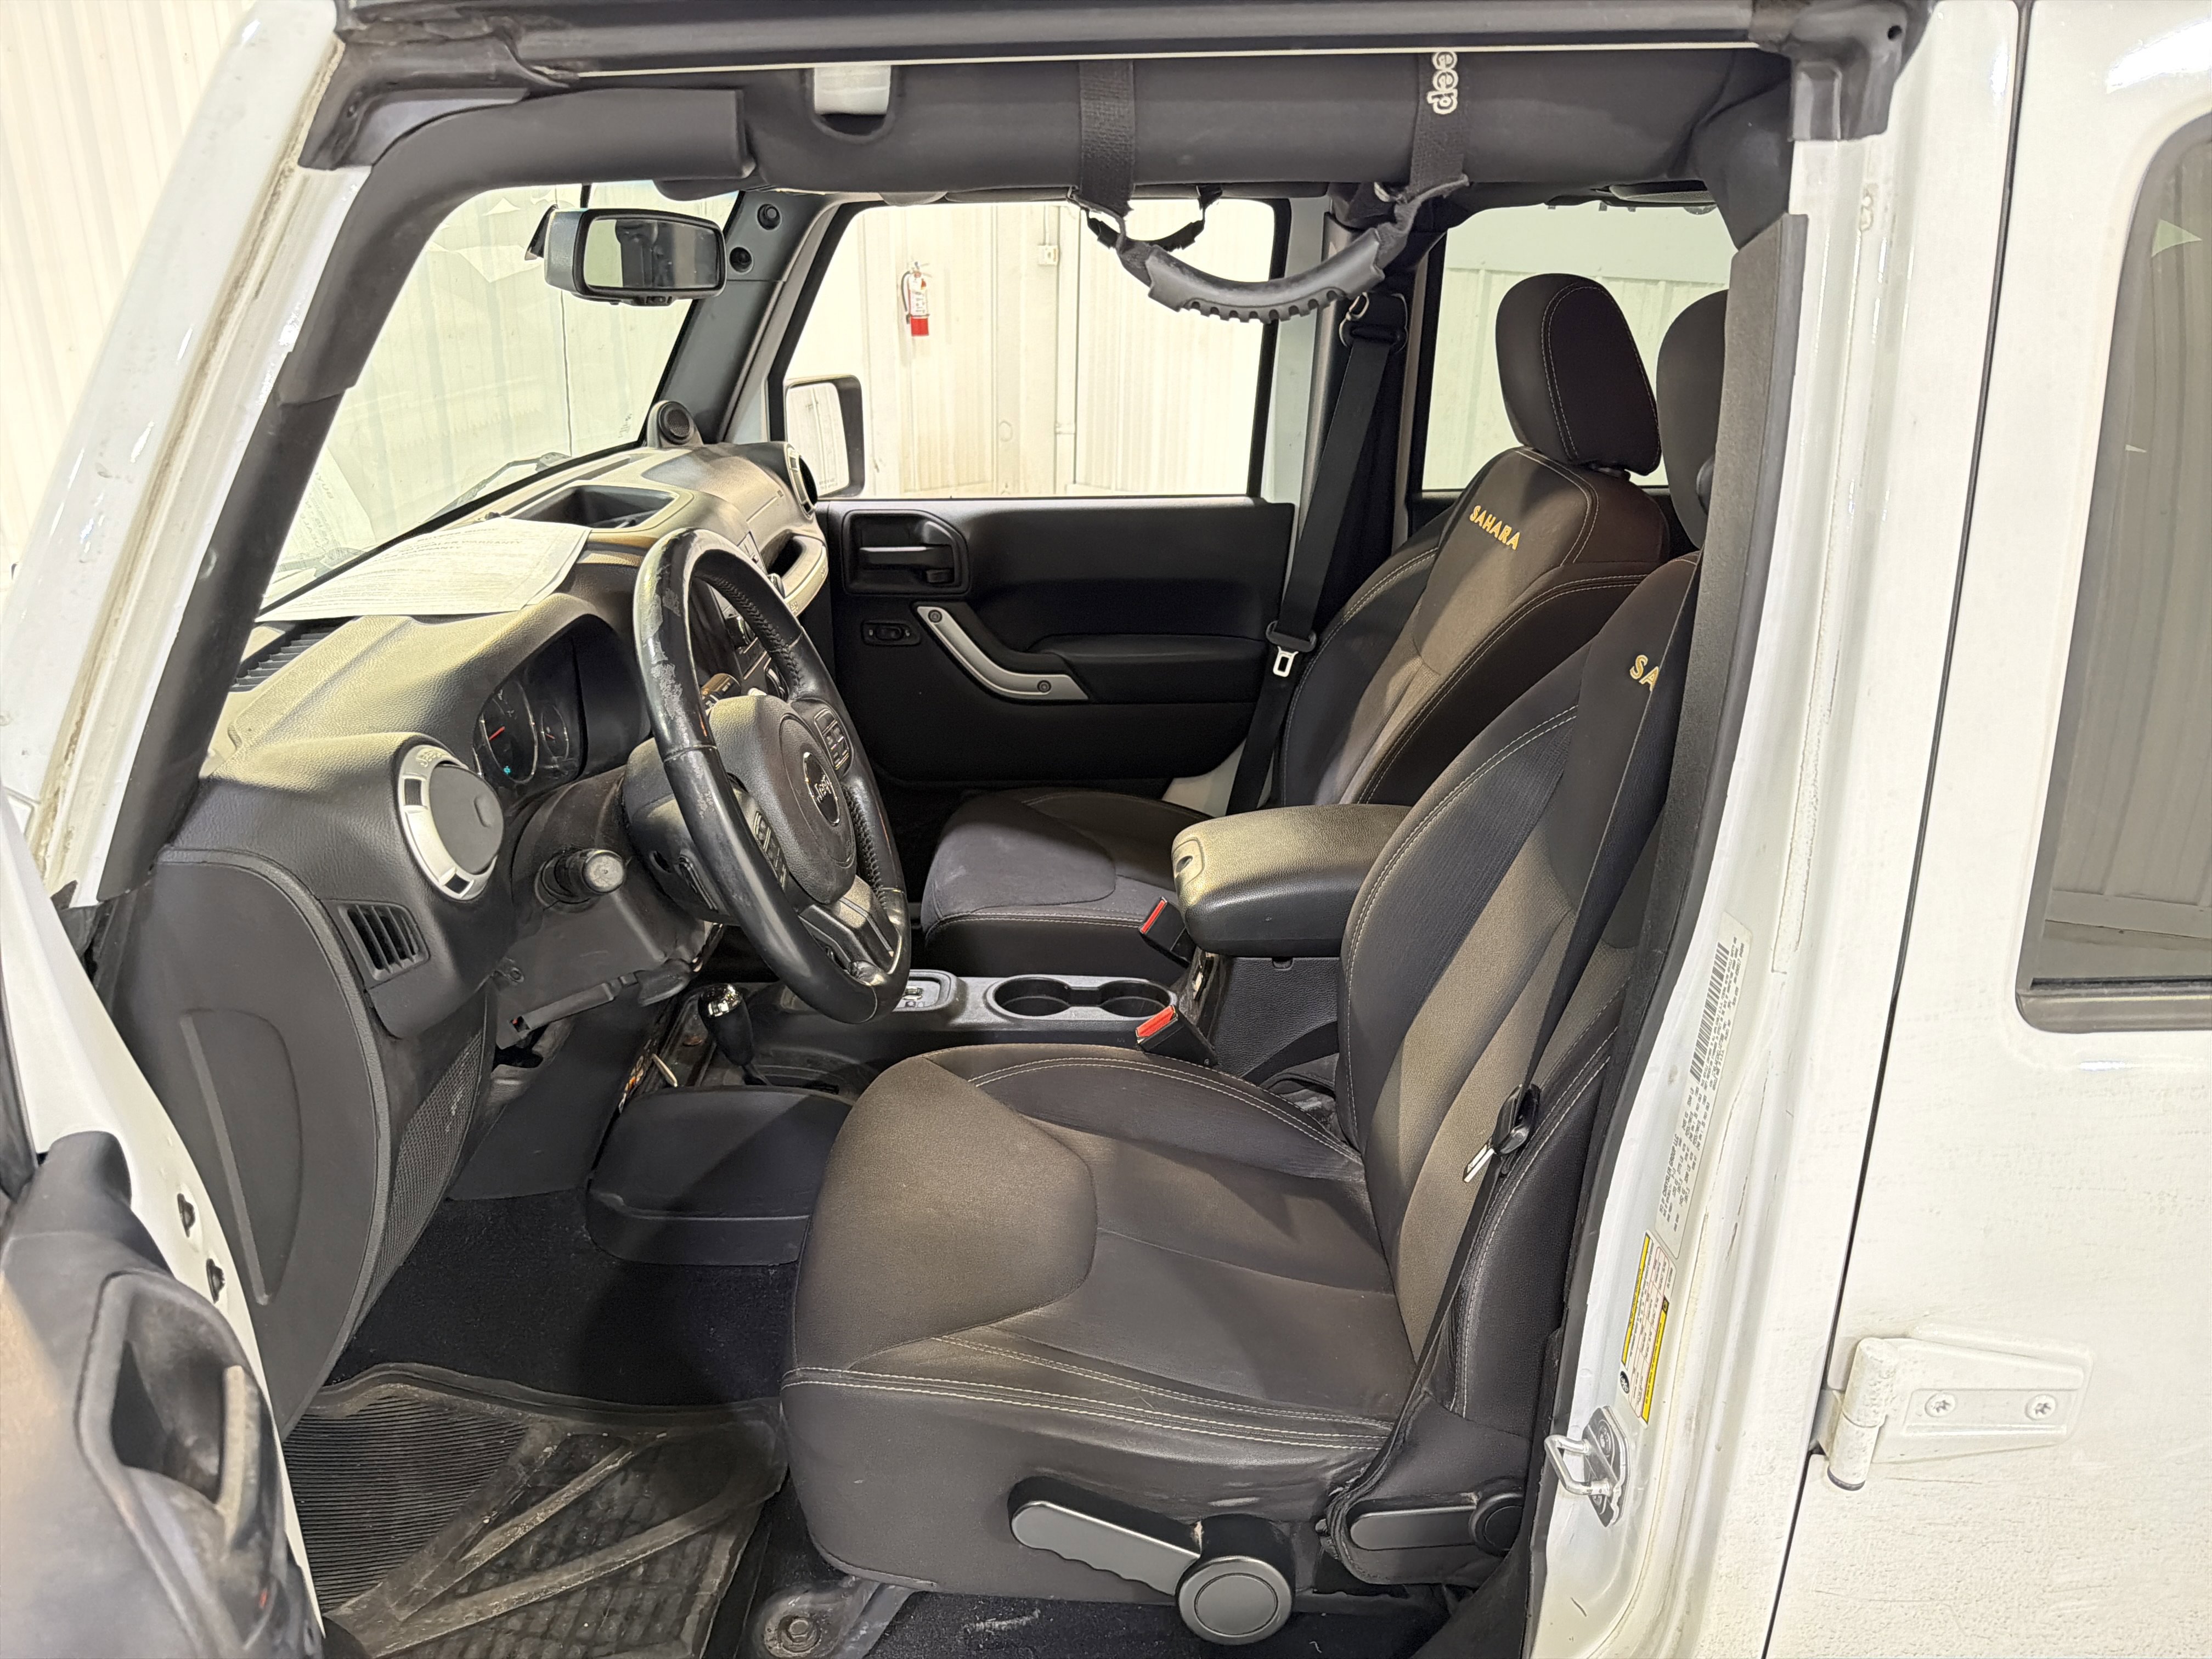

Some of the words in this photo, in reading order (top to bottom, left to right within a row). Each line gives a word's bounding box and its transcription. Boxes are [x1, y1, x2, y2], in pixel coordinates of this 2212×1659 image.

[1427, 51, 1459, 115] eep
[1469, 505, 1522, 551] SAHARA
[1629, 654, 1660, 692] SA
[814, 774, 832, 804] Jeep
[1662, 1166, 1672, 1197] CHRYSLER
